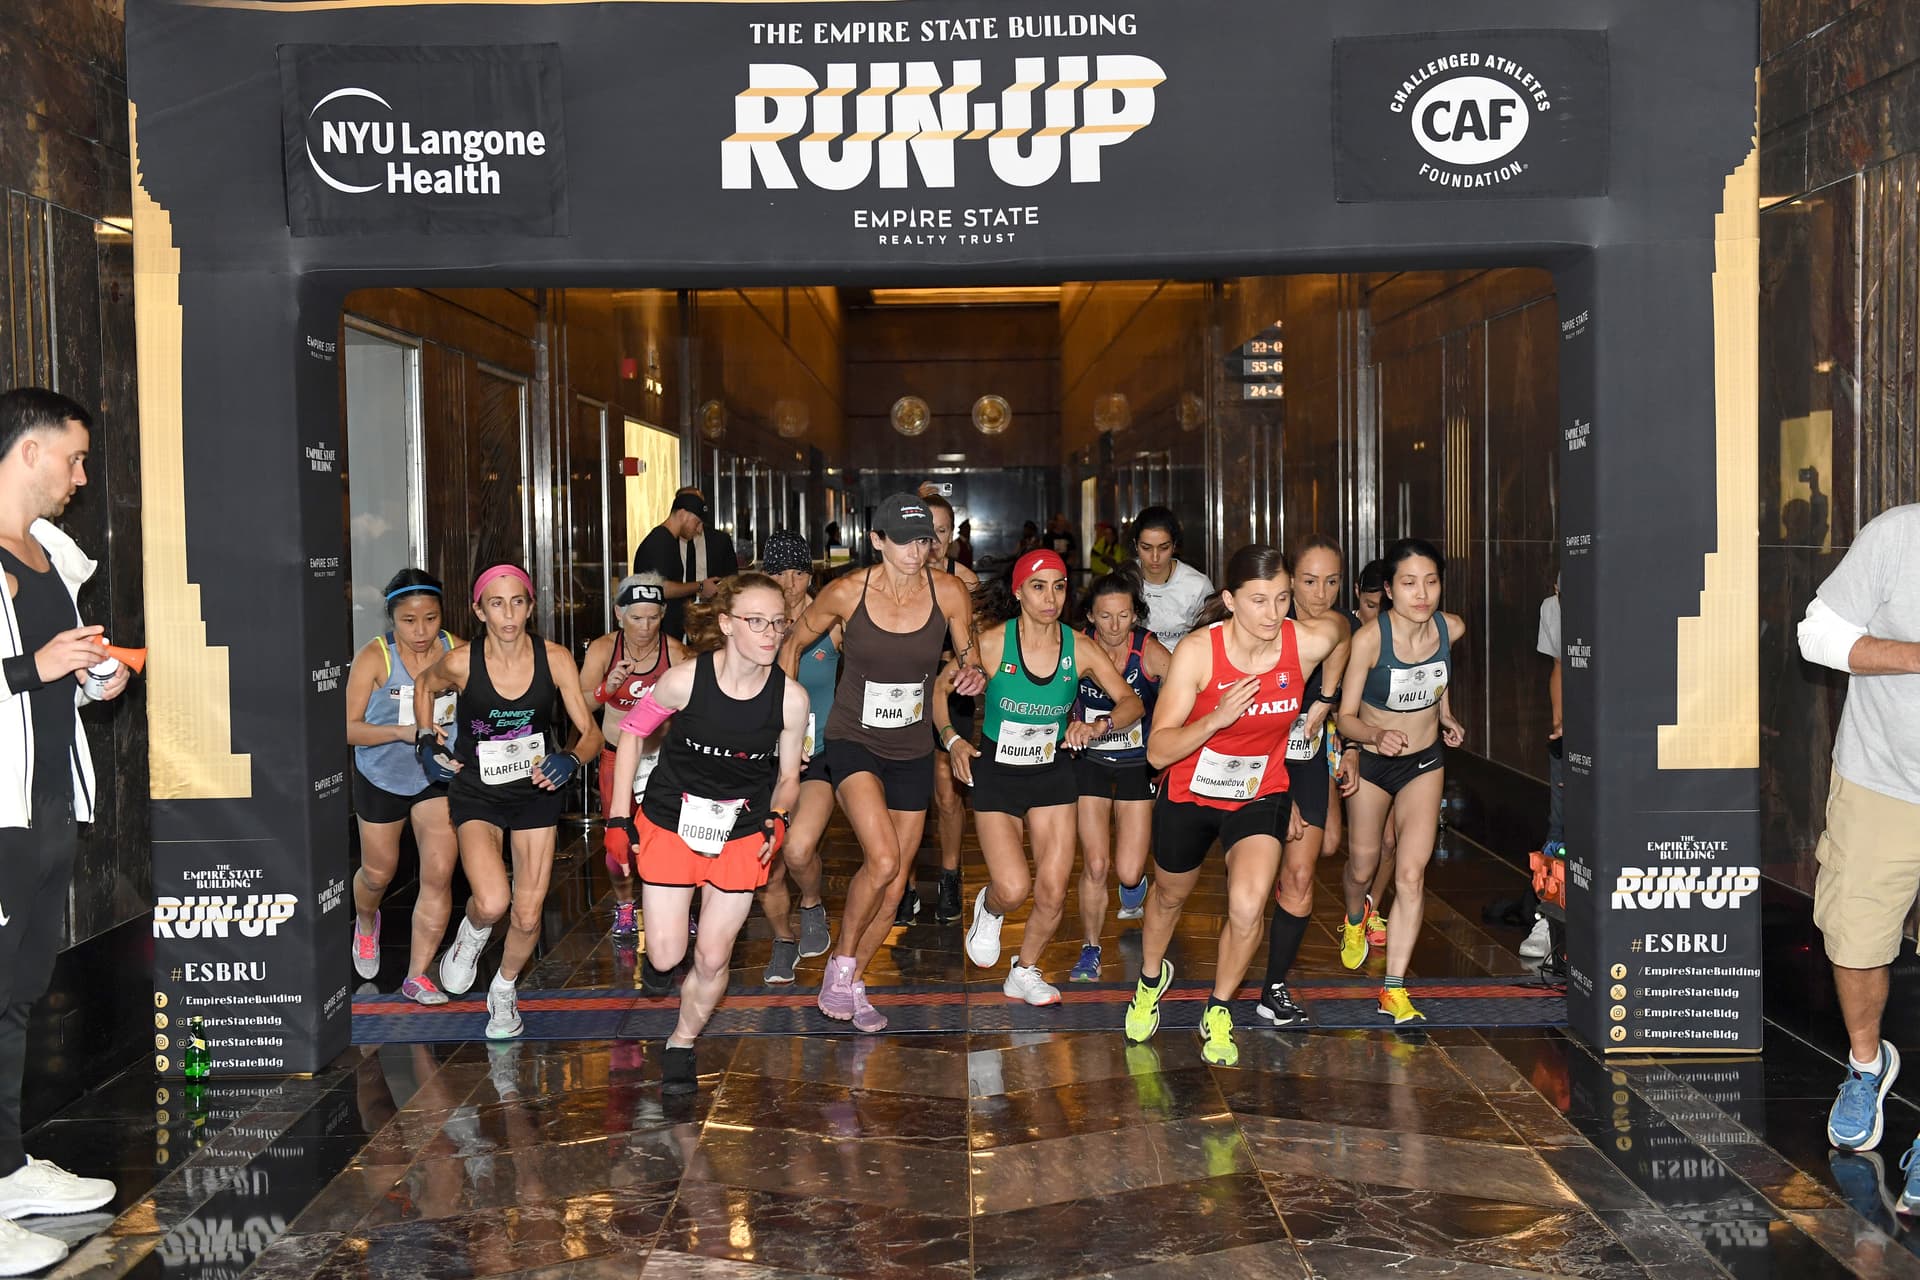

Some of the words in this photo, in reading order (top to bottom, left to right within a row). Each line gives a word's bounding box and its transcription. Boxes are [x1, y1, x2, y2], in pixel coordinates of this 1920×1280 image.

[749, 23, 803, 45] THE
[814, 21, 910, 43] EMPIRE
[920, 17, 998, 42] STATE
[1008, 14, 1137, 39] BUILDING
[1390, 53, 1480, 113] CHALLENGED
[1484, 54, 1552, 112] ATHLETES
[721, 54, 1167, 190] RUN-UP
[1421, 98, 1516, 143] CAF
[322, 121, 394, 154] NYU
[401, 122, 546, 162] Langone
[387, 162, 500, 195] Health
[854, 207, 952, 229] EMPIRE
[963, 206, 1040, 227] STATE
[879, 234, 948, 246] REALTY
[959, 232, 1016, 245] TRUST
[1398, 692, 1416, 703] YAU
[1417, 690, 1427, 700] LI
[875, 707, 903, 719] PAHA
[1000, 744, 1042, 757] AGUILAR
[1302, 751, 1311, 759] 33
[1035, 756, 1044, 764] 24
[483, 760, 530, 777] KLARFELD
[1235, 789, 1245, 798] 20
[681, 823, 732, 842] ROBBINS
[1647, 842, 1691, 852] EMPIRE
[1692, 841, 1728, 851] STATE
[1660, 850, 1715, 860] BUILDING
[183, 870, 228, 880] EMPIRE
[229, 869, 263, 880] STATE
[196, 879, 251, 889] BUILDING
[1611, 866, 1760, 909] RUN-UP
[153, 893, 298, 939] RUN-UP
[1630, 934, 1727, 953] #ESBRU
[170, 961, 266, 982] #ESBRU
[1633, 987, 1740, 999] @EmpireStateBldg
[1633, 1008, 1740, 1020] @EmpireStateBldg
[176, 1016, 283, 1028] @EpireStateBldg
[1633, 1029, 1740, 1041] @EmpireStateBldg
